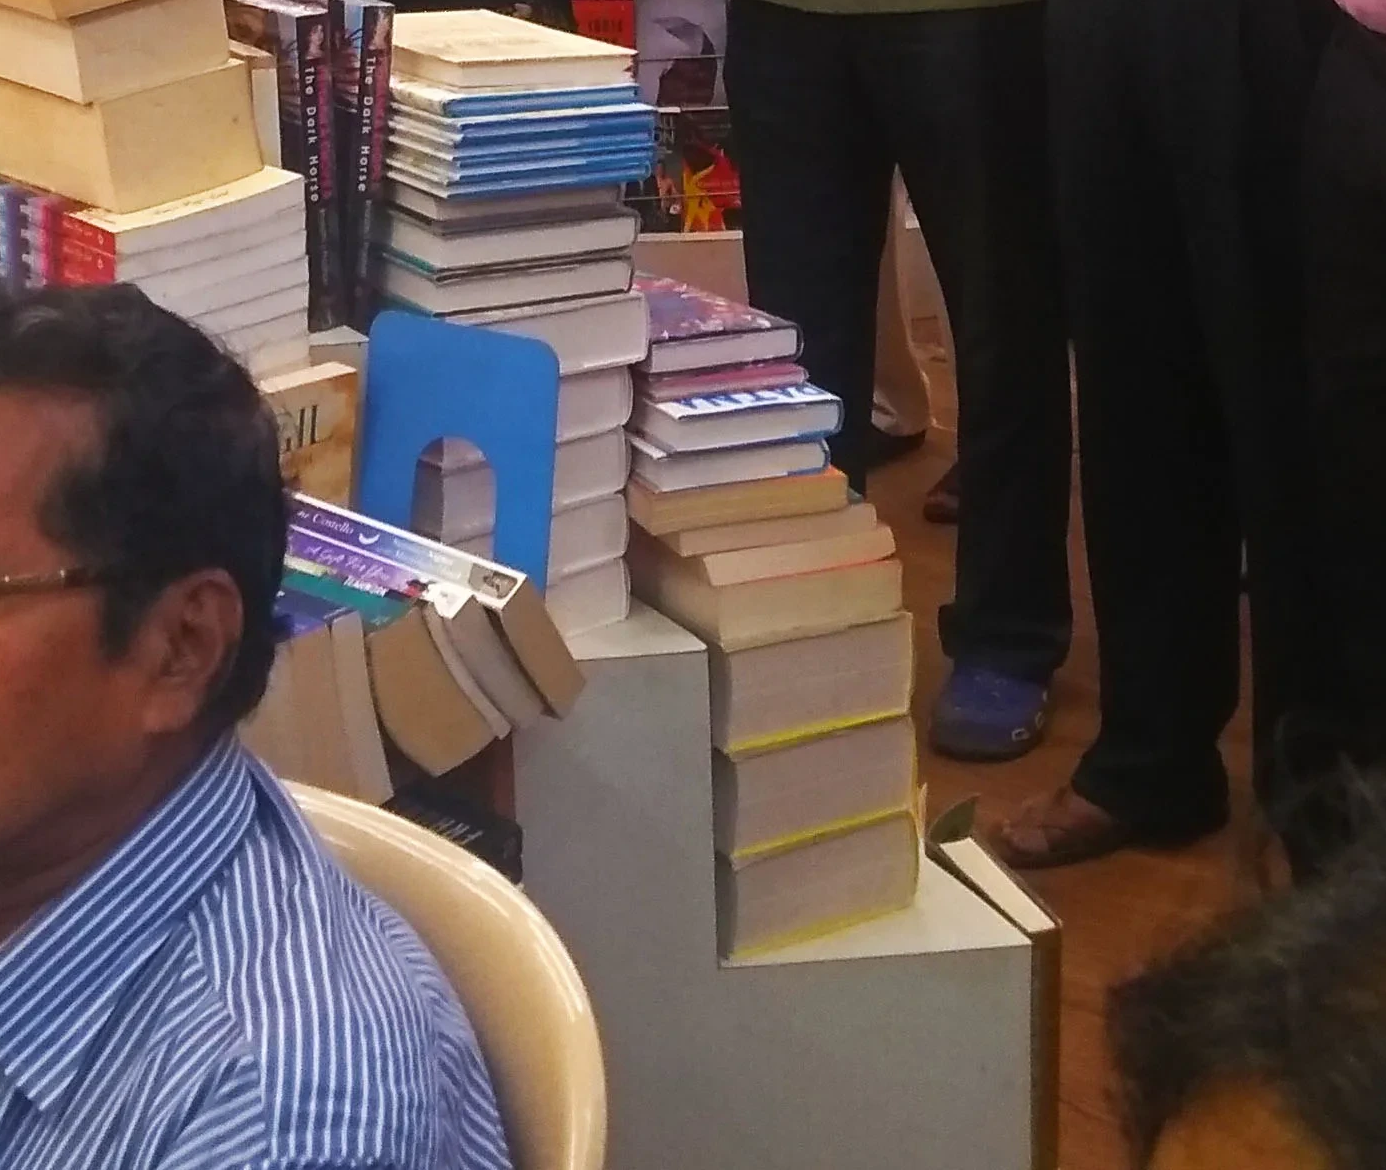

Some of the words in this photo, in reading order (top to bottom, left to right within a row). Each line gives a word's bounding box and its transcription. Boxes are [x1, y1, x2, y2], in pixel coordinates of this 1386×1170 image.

[364, 56, 377, 86] The
[306, 106, 317, 144] Dark
[362, 96, 374, 135] Dark
[309, 156, 319, 202] Horse
[358, 145, 371, 192] Horse
[312, 513, 354, 535] Costello
